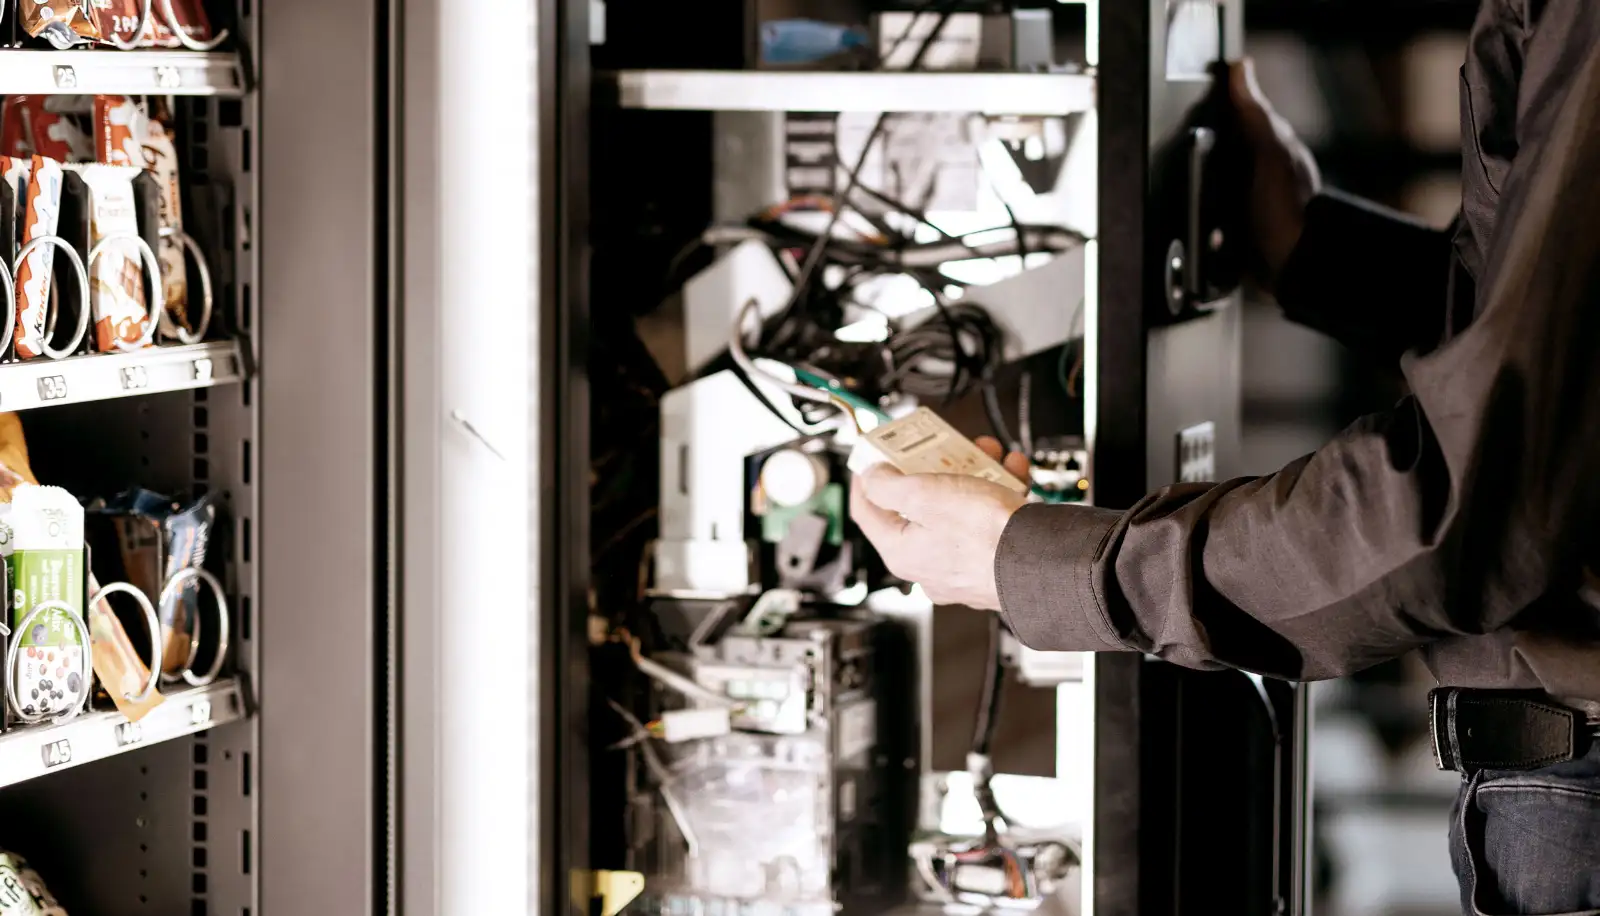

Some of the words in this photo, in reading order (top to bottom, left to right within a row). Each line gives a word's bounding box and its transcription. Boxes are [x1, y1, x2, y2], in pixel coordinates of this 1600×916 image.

[57, 66, 77, 88] 25
[44, 376, 67, 399] 35
[49, 739, 72, 764] 45
